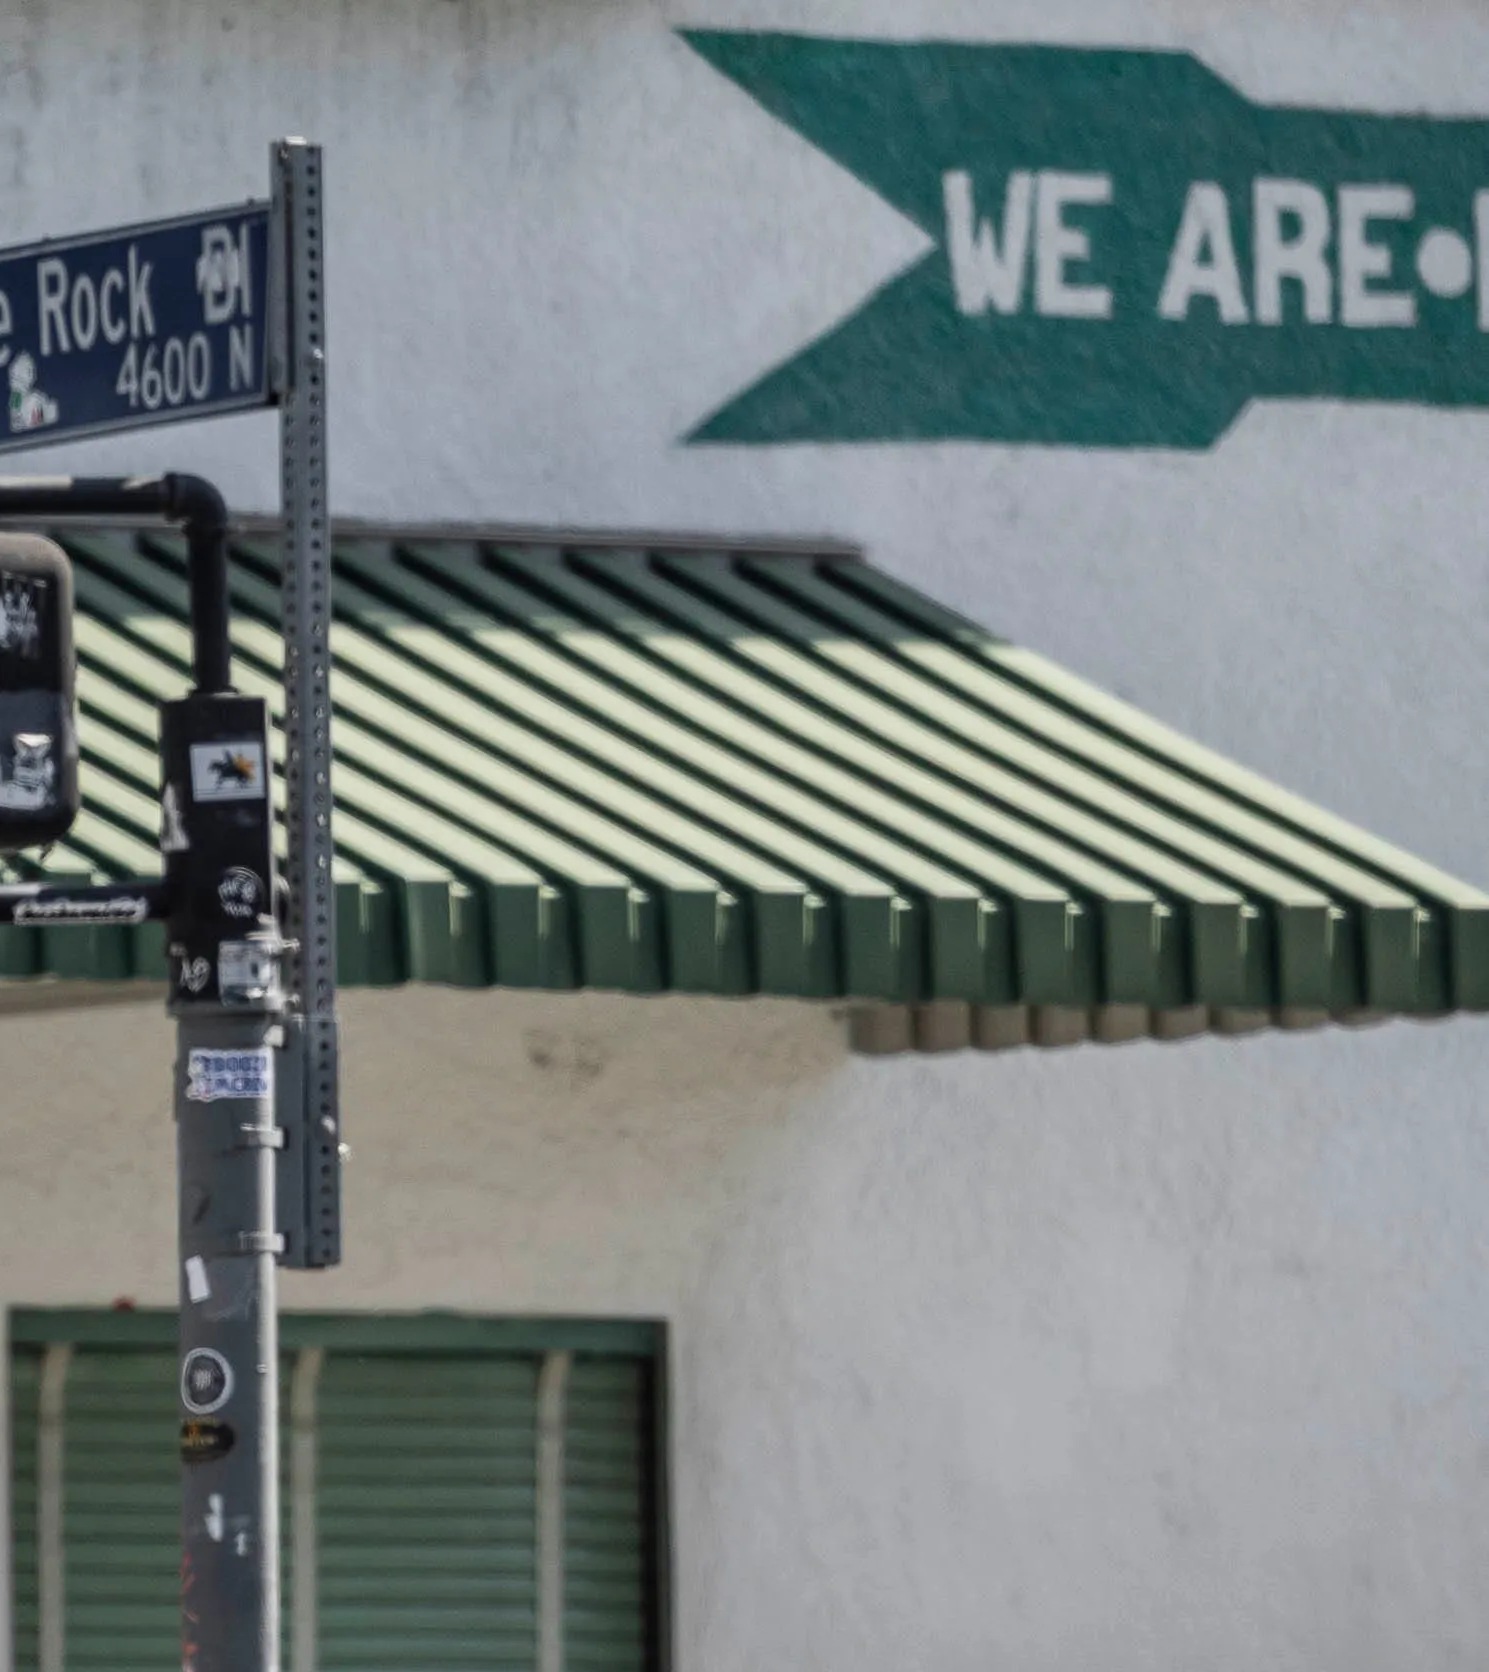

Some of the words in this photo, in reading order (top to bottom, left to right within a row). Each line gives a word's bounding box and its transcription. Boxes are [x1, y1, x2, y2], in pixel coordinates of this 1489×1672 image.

[36, 243, 157, 357] Rock
[941, 169, 1114, 319] WE
[115, 331, 212, 409] 4600
[228, 323, 255, 391] N
